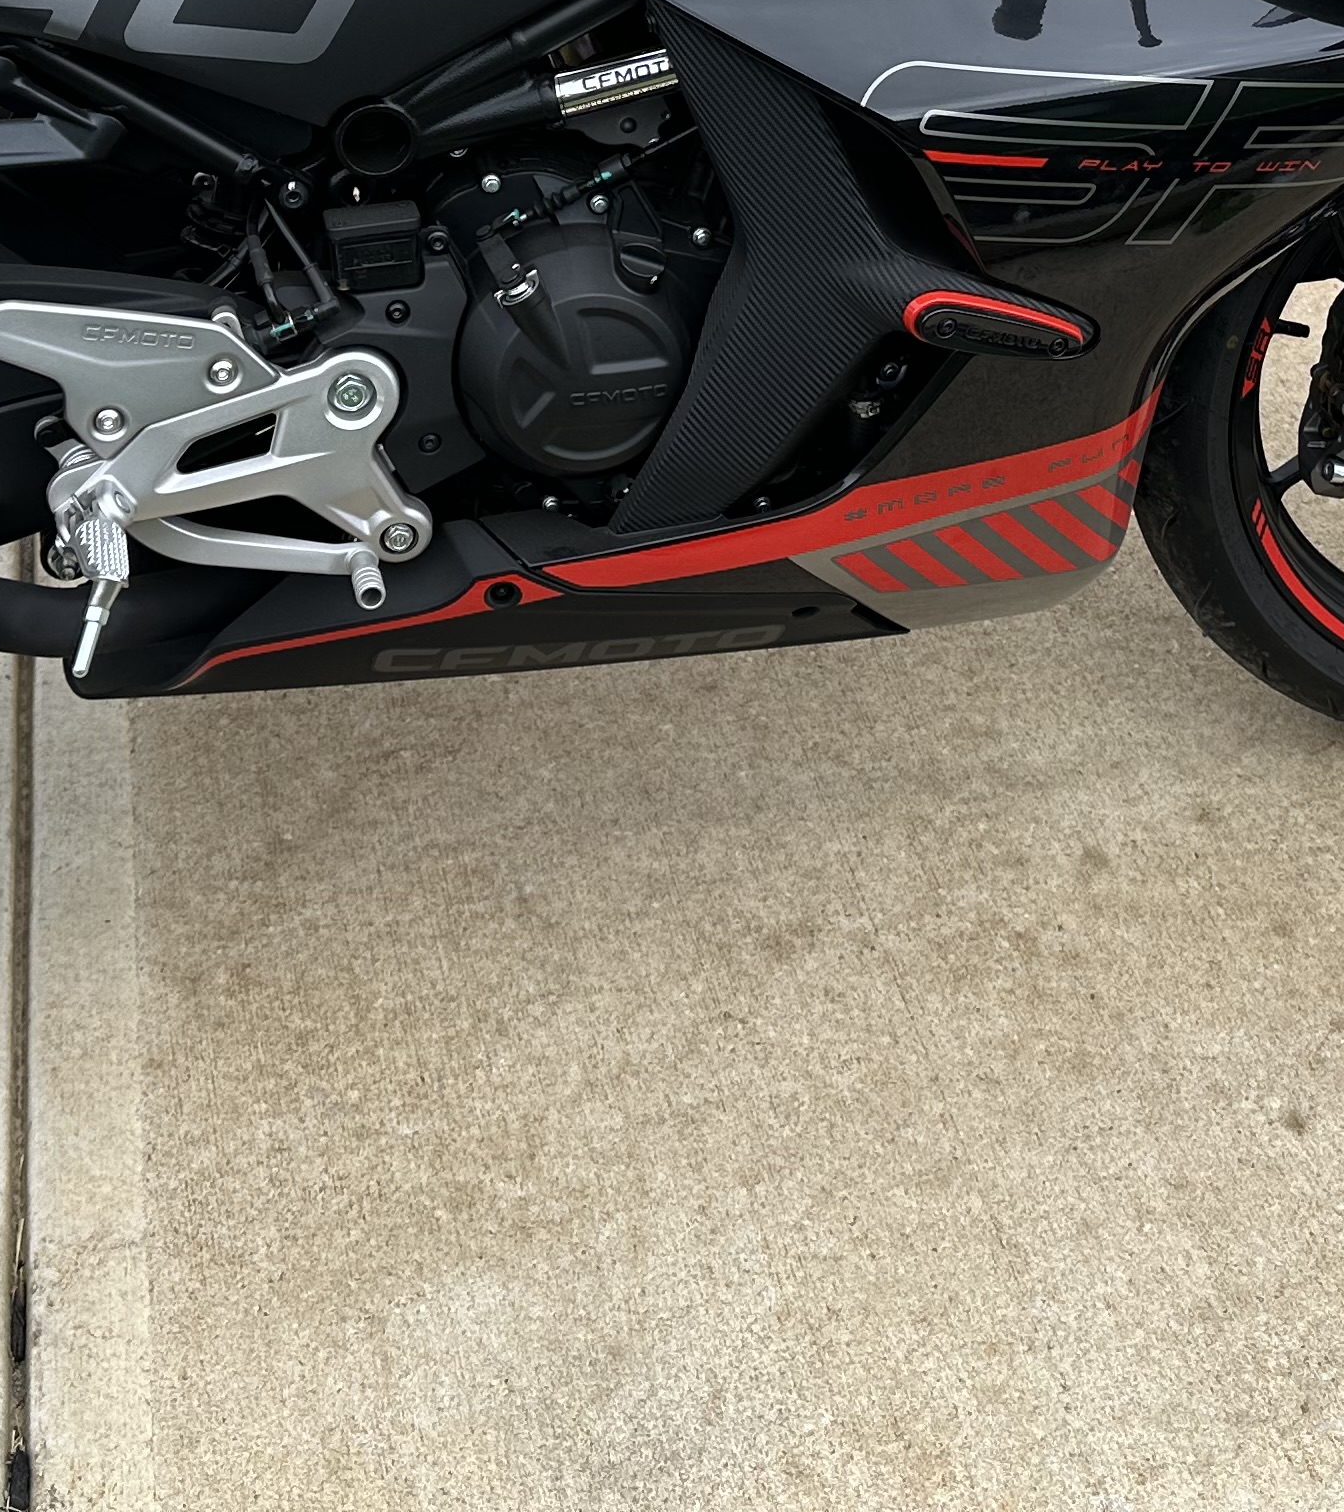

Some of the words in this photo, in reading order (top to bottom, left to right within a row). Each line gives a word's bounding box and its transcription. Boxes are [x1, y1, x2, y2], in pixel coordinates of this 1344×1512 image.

[582, 59, 672, 91] CFMOT
[1077, 159, 1164, 171] PLAY
[1192, 161, 1233, 174] TO
[1256, 159, 1322, 173] WIN
[81, 325, 196, 350] CFMOTO
[569, 383, 668, 407] CFMOTO
[373, 624, 787, 672] CFMOTO
